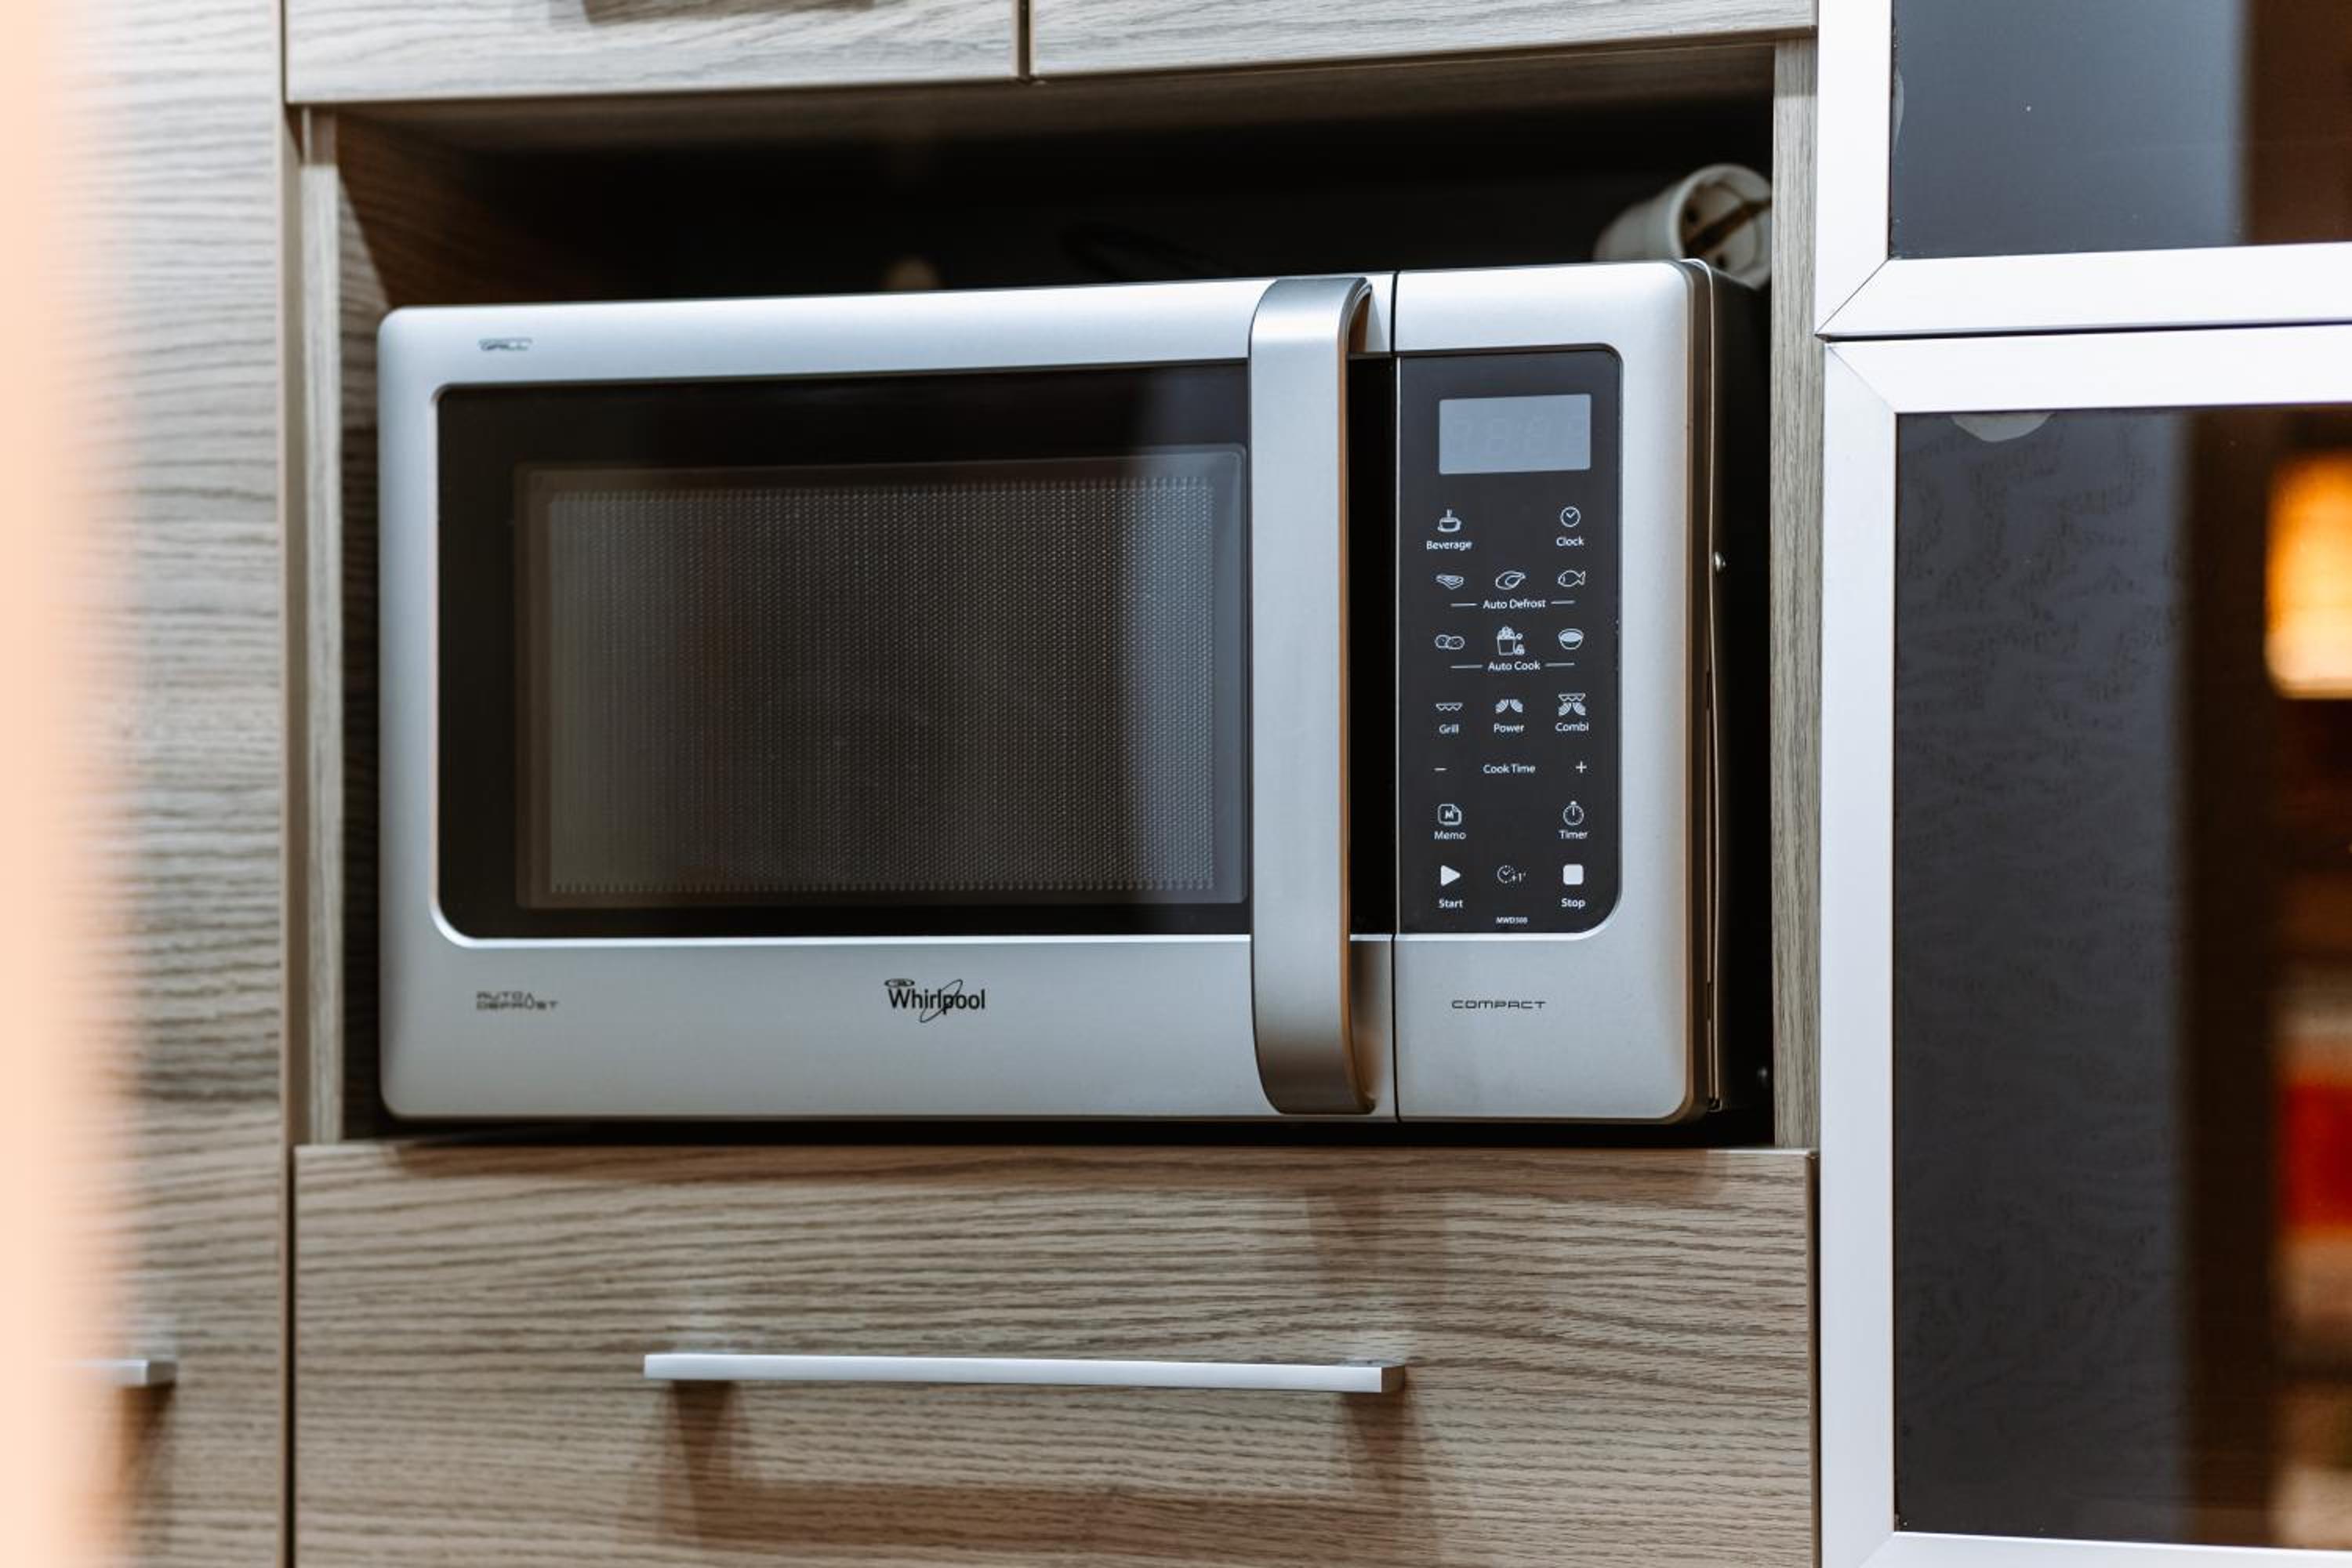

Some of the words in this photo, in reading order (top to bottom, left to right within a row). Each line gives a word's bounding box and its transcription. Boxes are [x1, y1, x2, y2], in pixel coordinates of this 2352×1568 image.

[1426, 540, 1472, 551] Beverage
[1555, 535, 1584, 547] Clock
[1483, 599, 1508, 609] Auto
[1509, 598, 1547, 609] Defrost
[1488, 662, 1512, 672] Auto
[1514, 661, 1541, 671] Cook
[1439, 724, 1460, 735] Grill
[1494, 722, 1525, 733] Power
[1555, 721, 1590, 733] Combi
[1483, 764, 1510, 774] Cook
[1511, 763, 1537, 774] Time
[1434, 830, 1467, 840] Memo
[1559, 829, 1588, 840] Timer
[1439, 898, 1464, 909] Start
[1561, 898, 1586, 909] Stop
[887, 988, 985, 1015] Whirlpool
[1451, 1000, 1547, 1010] COMPACT
